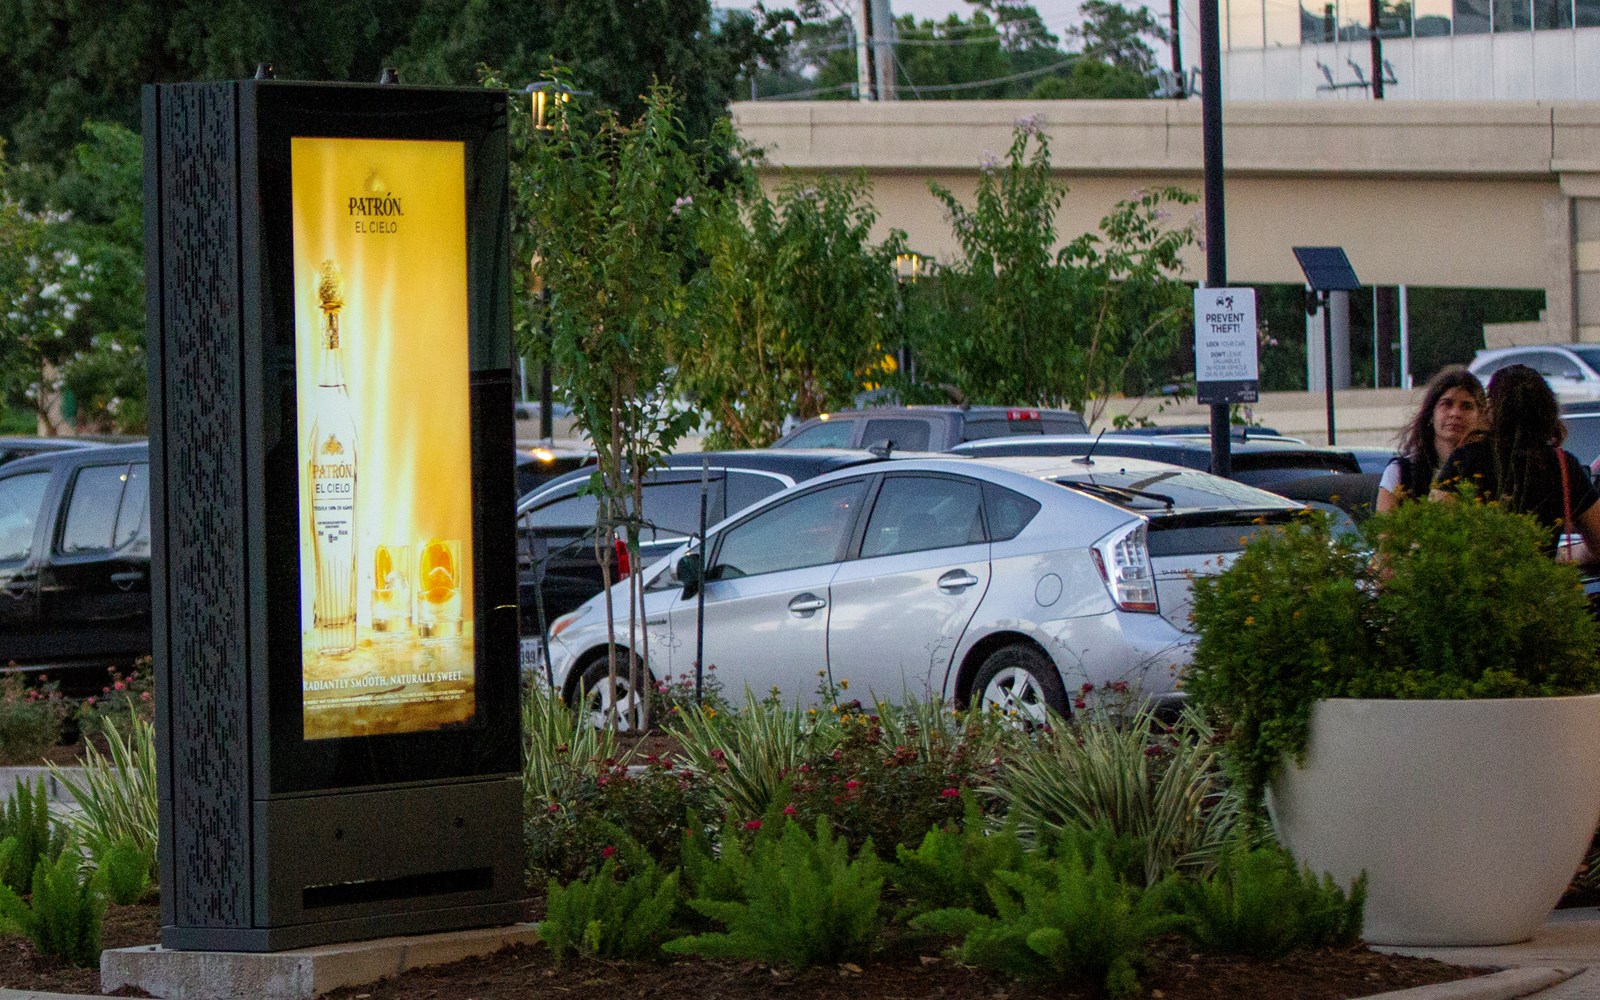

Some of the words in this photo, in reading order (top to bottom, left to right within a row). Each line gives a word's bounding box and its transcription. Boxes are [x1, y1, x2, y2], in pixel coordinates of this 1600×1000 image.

[355, 221, 367, 233] EL
[369, 221, 397, 233] CIELO
[1206, 313, 1244, 322] PREVENT
[1211, 323, 1240, 333] THEFT!
[315, 483, 325, 493] EL
[327, 483, 350, 493] CIELO
[303, 680, 349, 691] RADIANTLY
[390, 673, 435, 685] NATURALLY
[437, 671, 464, 682] SWEET.
